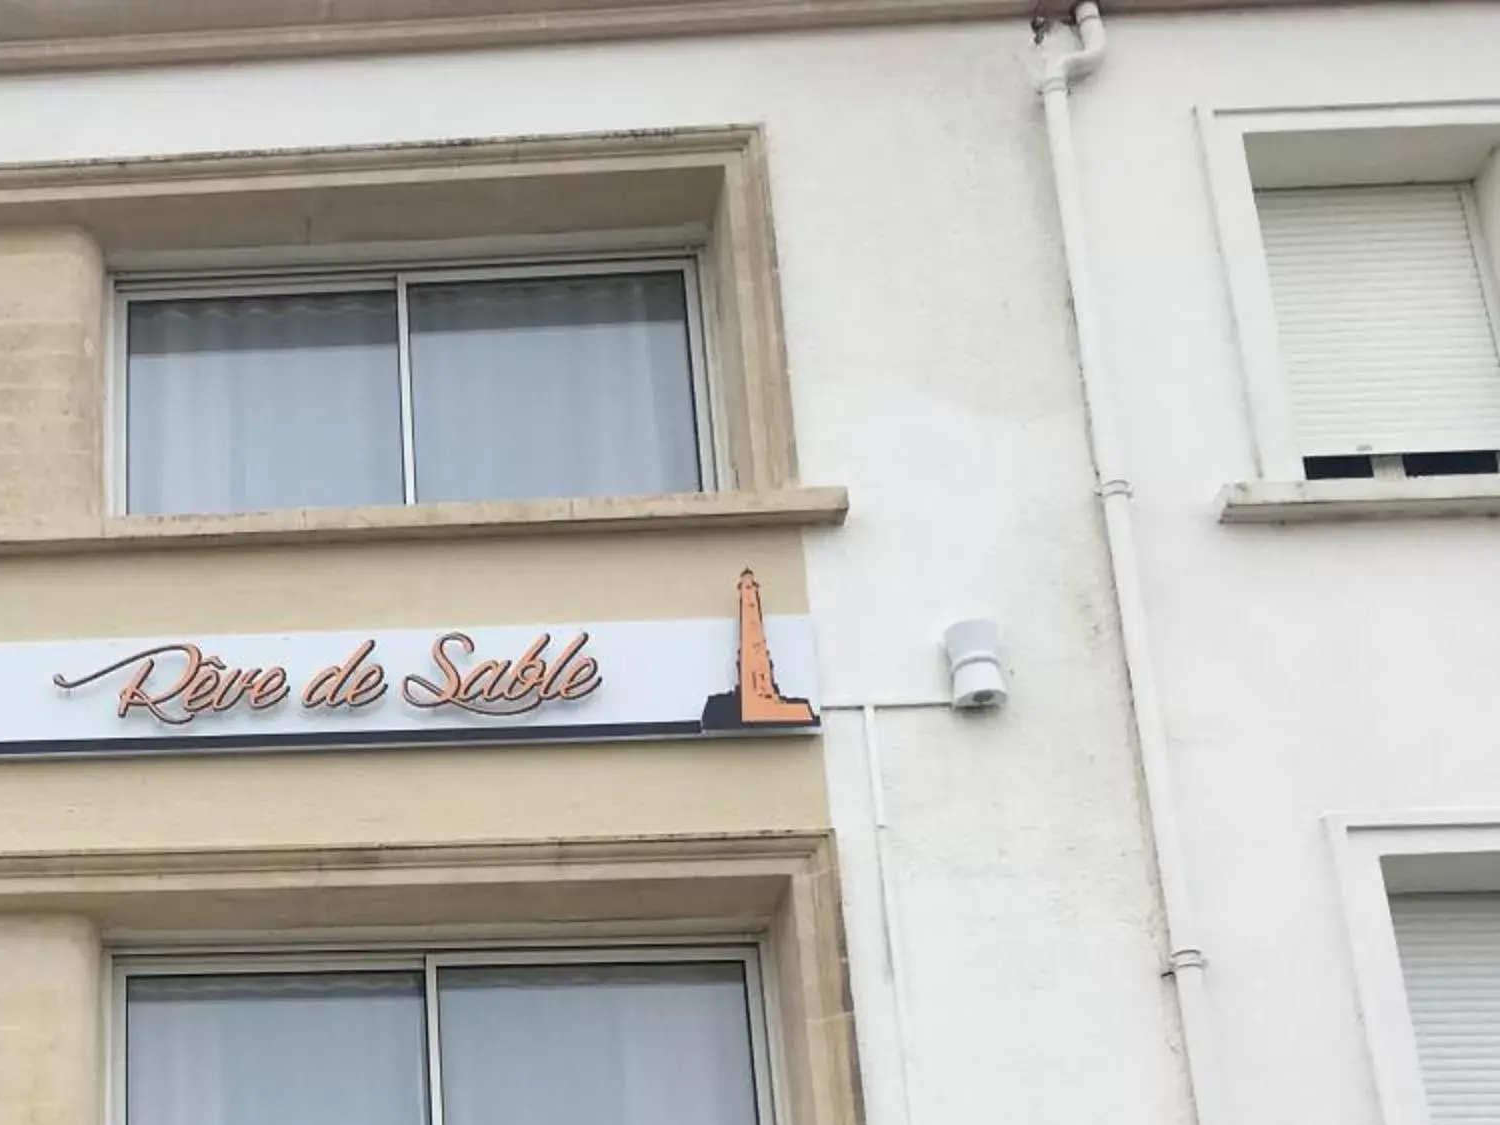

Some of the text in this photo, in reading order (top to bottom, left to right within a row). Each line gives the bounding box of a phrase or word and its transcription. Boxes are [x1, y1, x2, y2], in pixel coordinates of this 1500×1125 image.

[53, 631, 602, 726] Rêve de Sable
